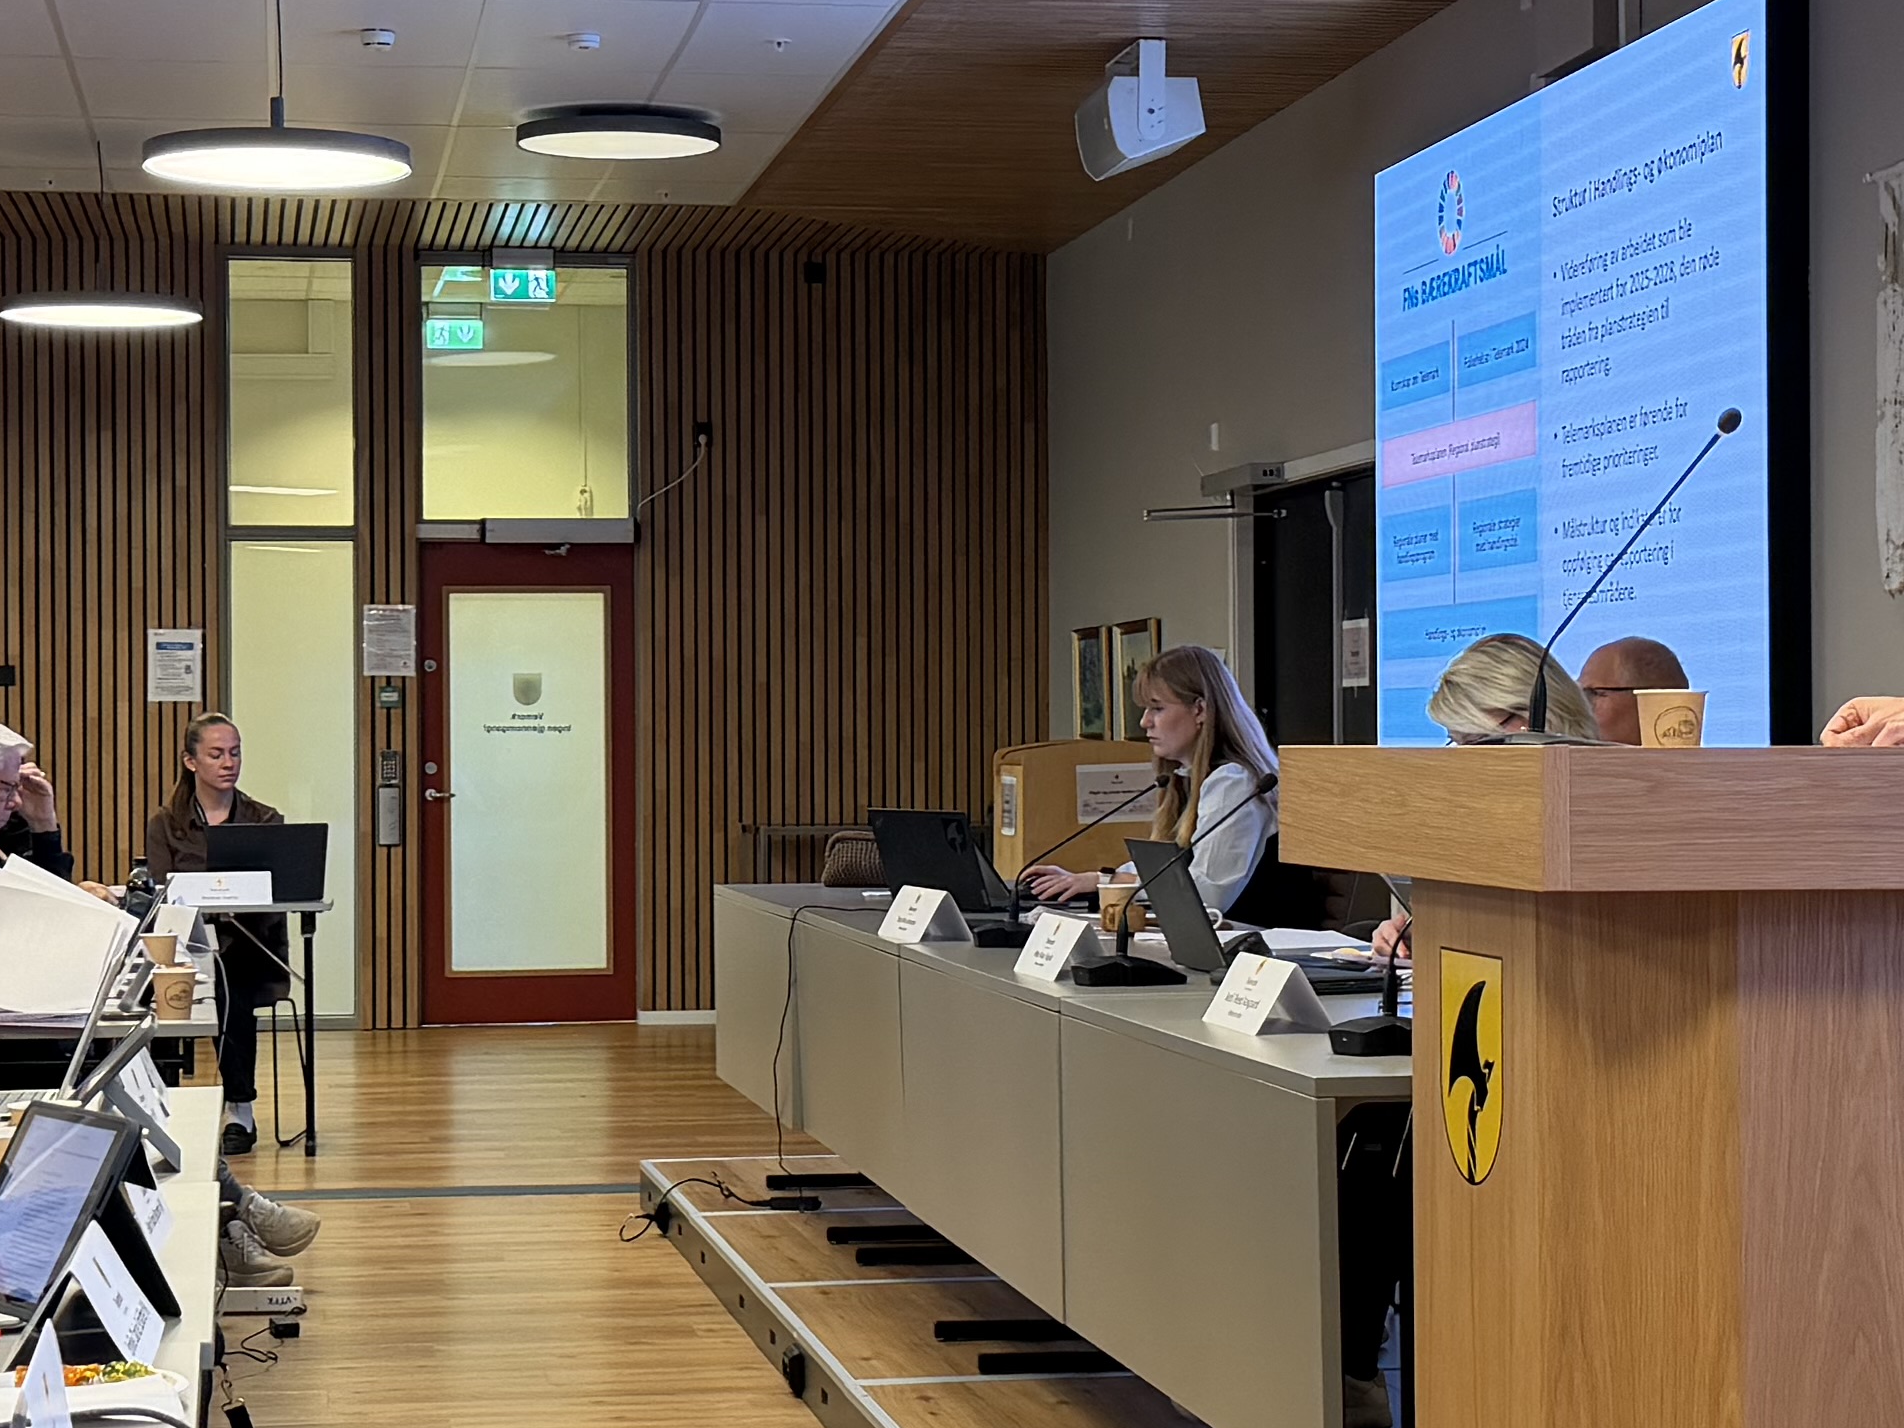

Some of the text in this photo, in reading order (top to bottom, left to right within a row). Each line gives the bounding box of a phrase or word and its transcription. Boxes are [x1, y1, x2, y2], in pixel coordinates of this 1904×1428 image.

[1552, 186, 1587, 218] Struktur
[1642, 159, 1655, 184] og
[1656, 130, 1723, 178] økonomiplan
[1560, 250, 1609, 282] Videreføring
[1620, 232, 1656, 262] arbeidet
[1657, 227, 1676, 250] som
[1678, 254, 1696, 278] den
[1402, 286, 1419, 313] FNs
